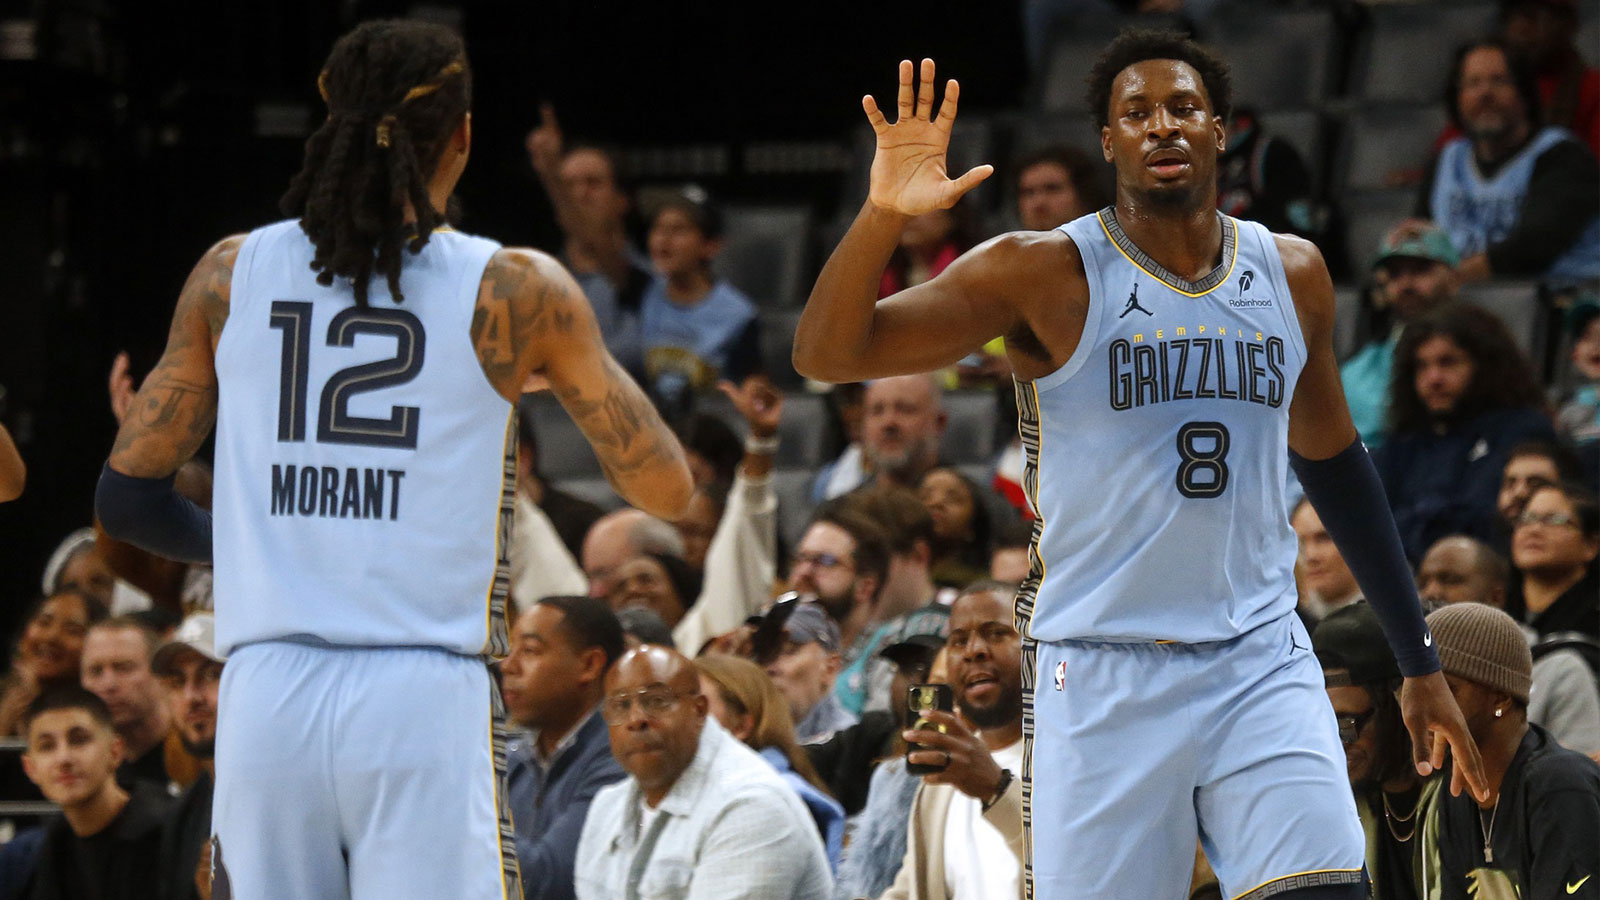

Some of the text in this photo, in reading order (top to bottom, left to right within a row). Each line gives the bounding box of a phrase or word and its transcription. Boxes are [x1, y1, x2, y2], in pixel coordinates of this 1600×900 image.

[1133, 325, 1263, 343] MEMPHIS
[1228, 298, 1273, 307] Robinhood
[269, 300, 426, 450] 12
[1108, 336, 1285, 412] GRIZZLIES
[270, 464, 405, 521] MORANT
[1176, 421, 1230, 499] 8
